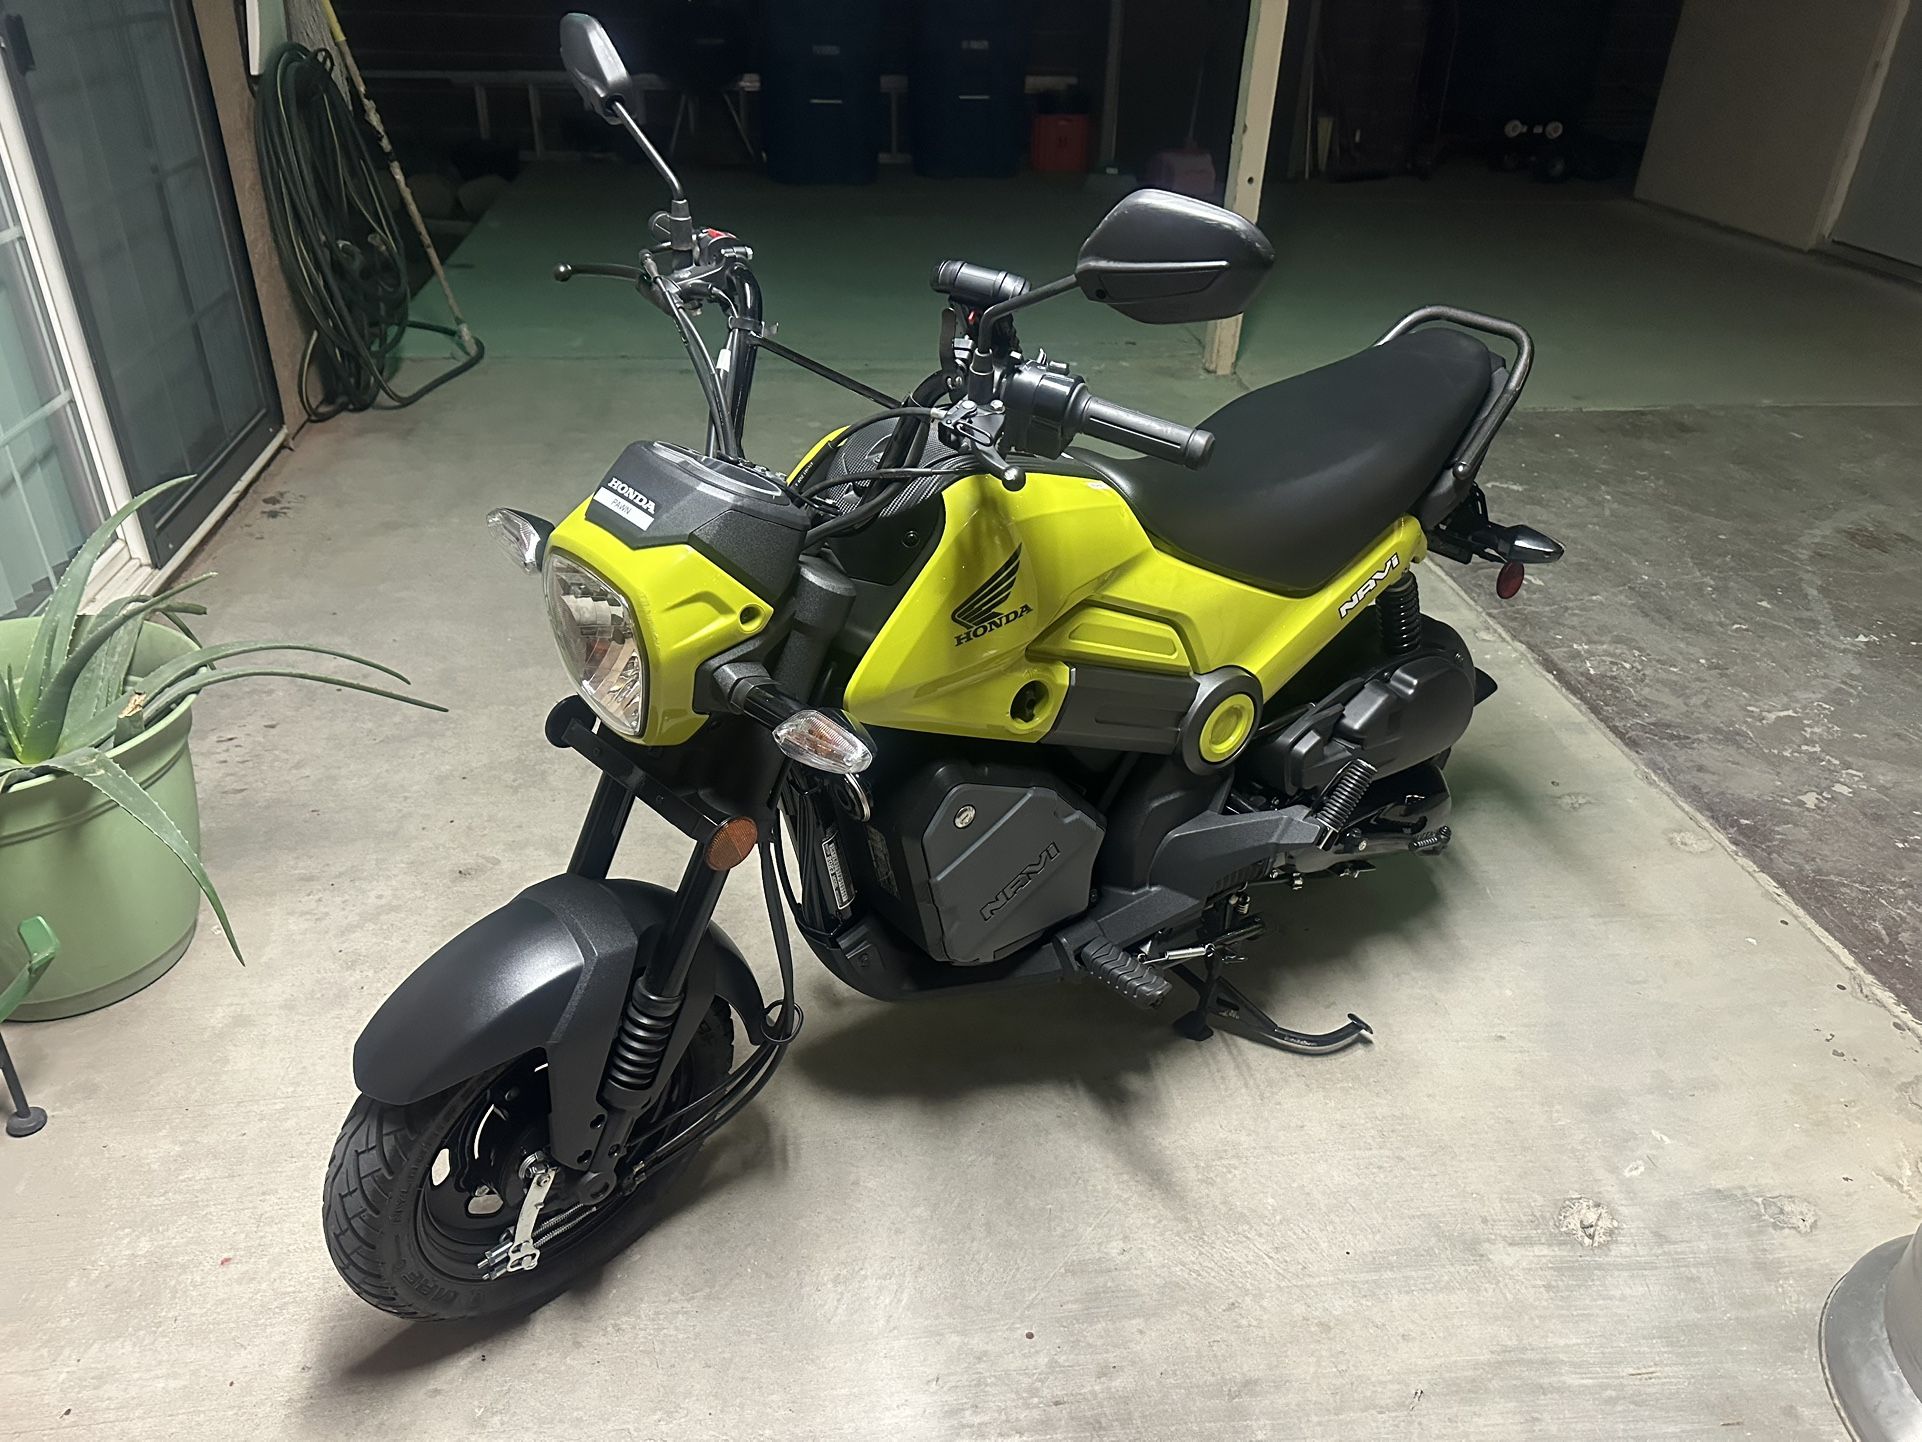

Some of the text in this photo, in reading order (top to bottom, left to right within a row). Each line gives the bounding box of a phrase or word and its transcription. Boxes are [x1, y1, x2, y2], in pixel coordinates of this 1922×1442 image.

[607, 477, 656, 514] HONDA
[611, 498, 632, 515] PAWN
[1338, 552, 1400, 619] NAVI
[954, 603, 1033, 647] HONDA
[979, 842, 1060, 921] NAVI
